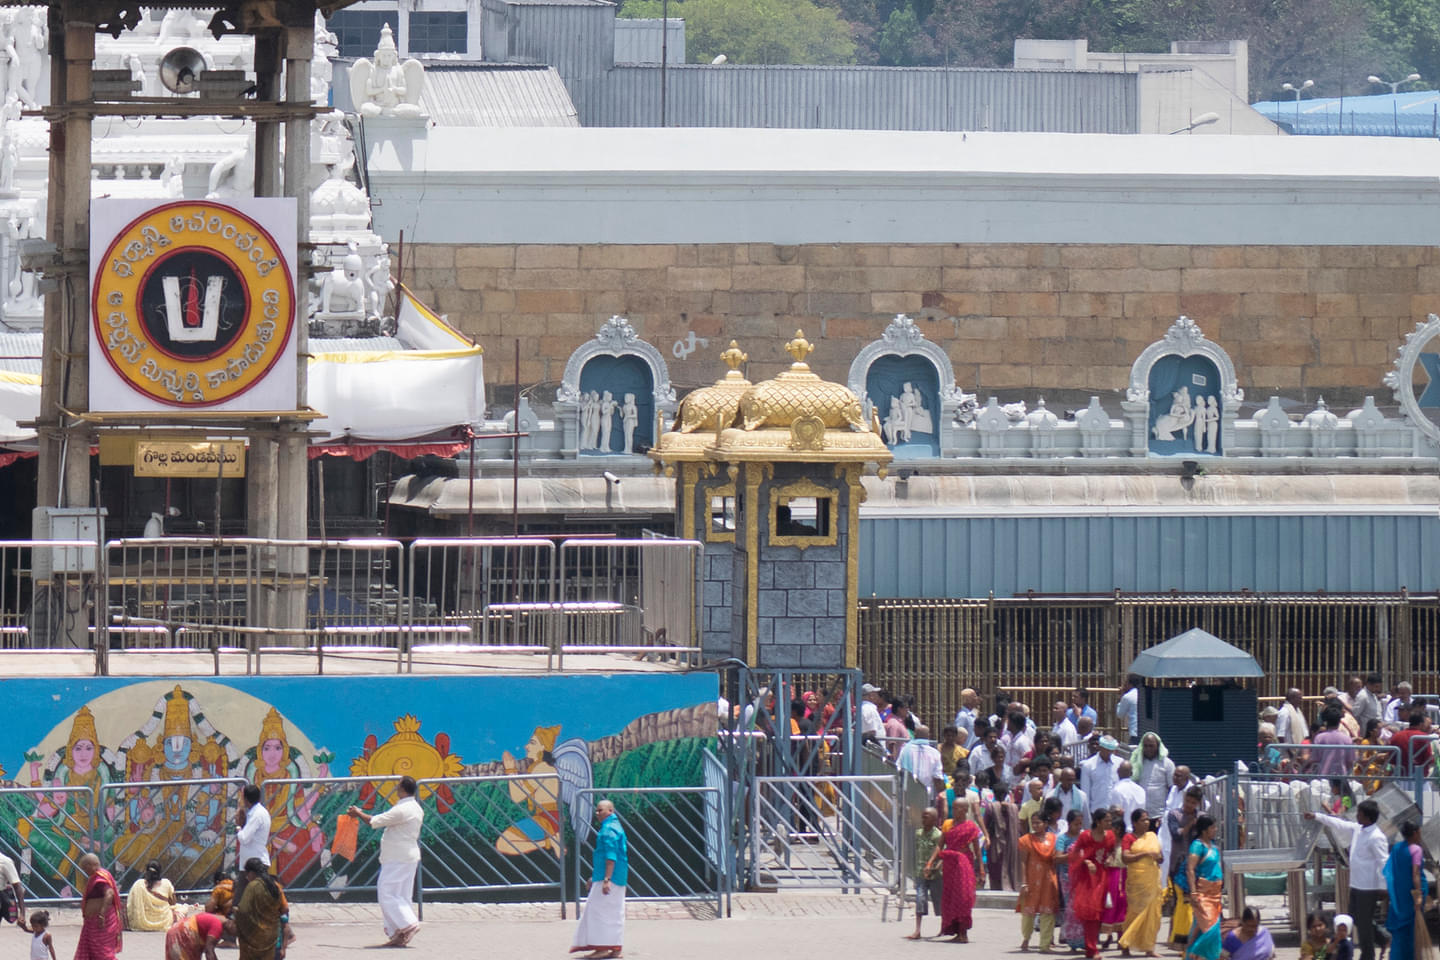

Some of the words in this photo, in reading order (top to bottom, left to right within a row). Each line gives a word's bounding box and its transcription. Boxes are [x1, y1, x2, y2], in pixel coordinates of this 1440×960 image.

[111, 223, 172, 278] ధర్మాన్ని
[169, 210, 280, 278] ఆచరించండి
[205, 289, 281, 390] కాపాడుతుంది
[143, 450, 168, 467] గొల్ల
